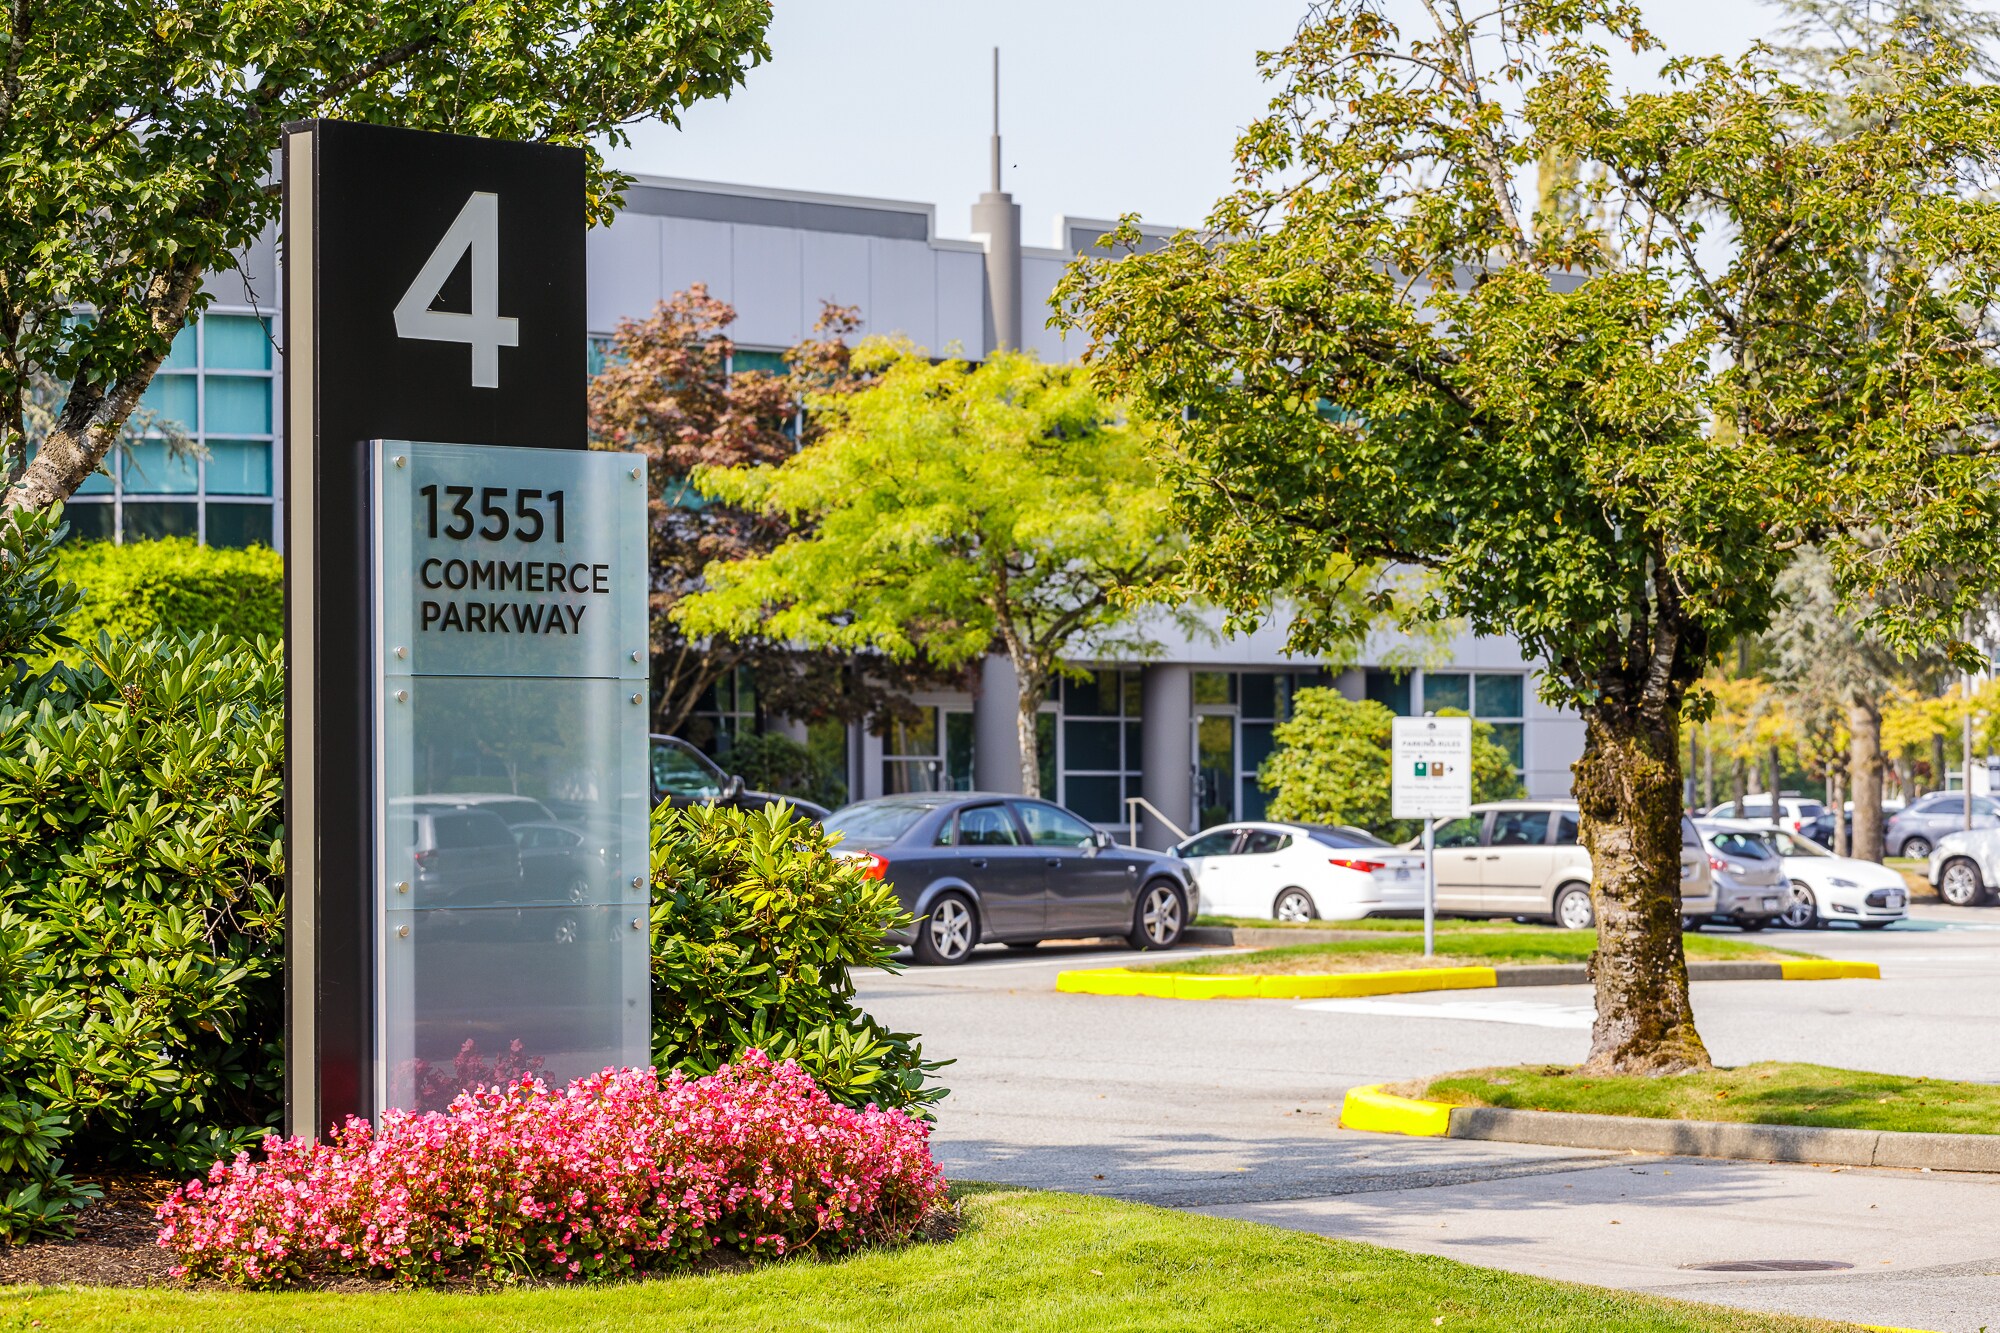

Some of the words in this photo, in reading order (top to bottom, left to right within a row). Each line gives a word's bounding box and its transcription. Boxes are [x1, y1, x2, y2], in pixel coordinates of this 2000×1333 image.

[393, 190, 519, 389] 4
[420, 484, 565, 544] 13551
[420, 557, 610, 594] COMMERCE
[420, 600, 587, 635] PARKWAY
[1402, 740, 1437, 748] PARKING
[1438, 740, 1461, 748] RULES
